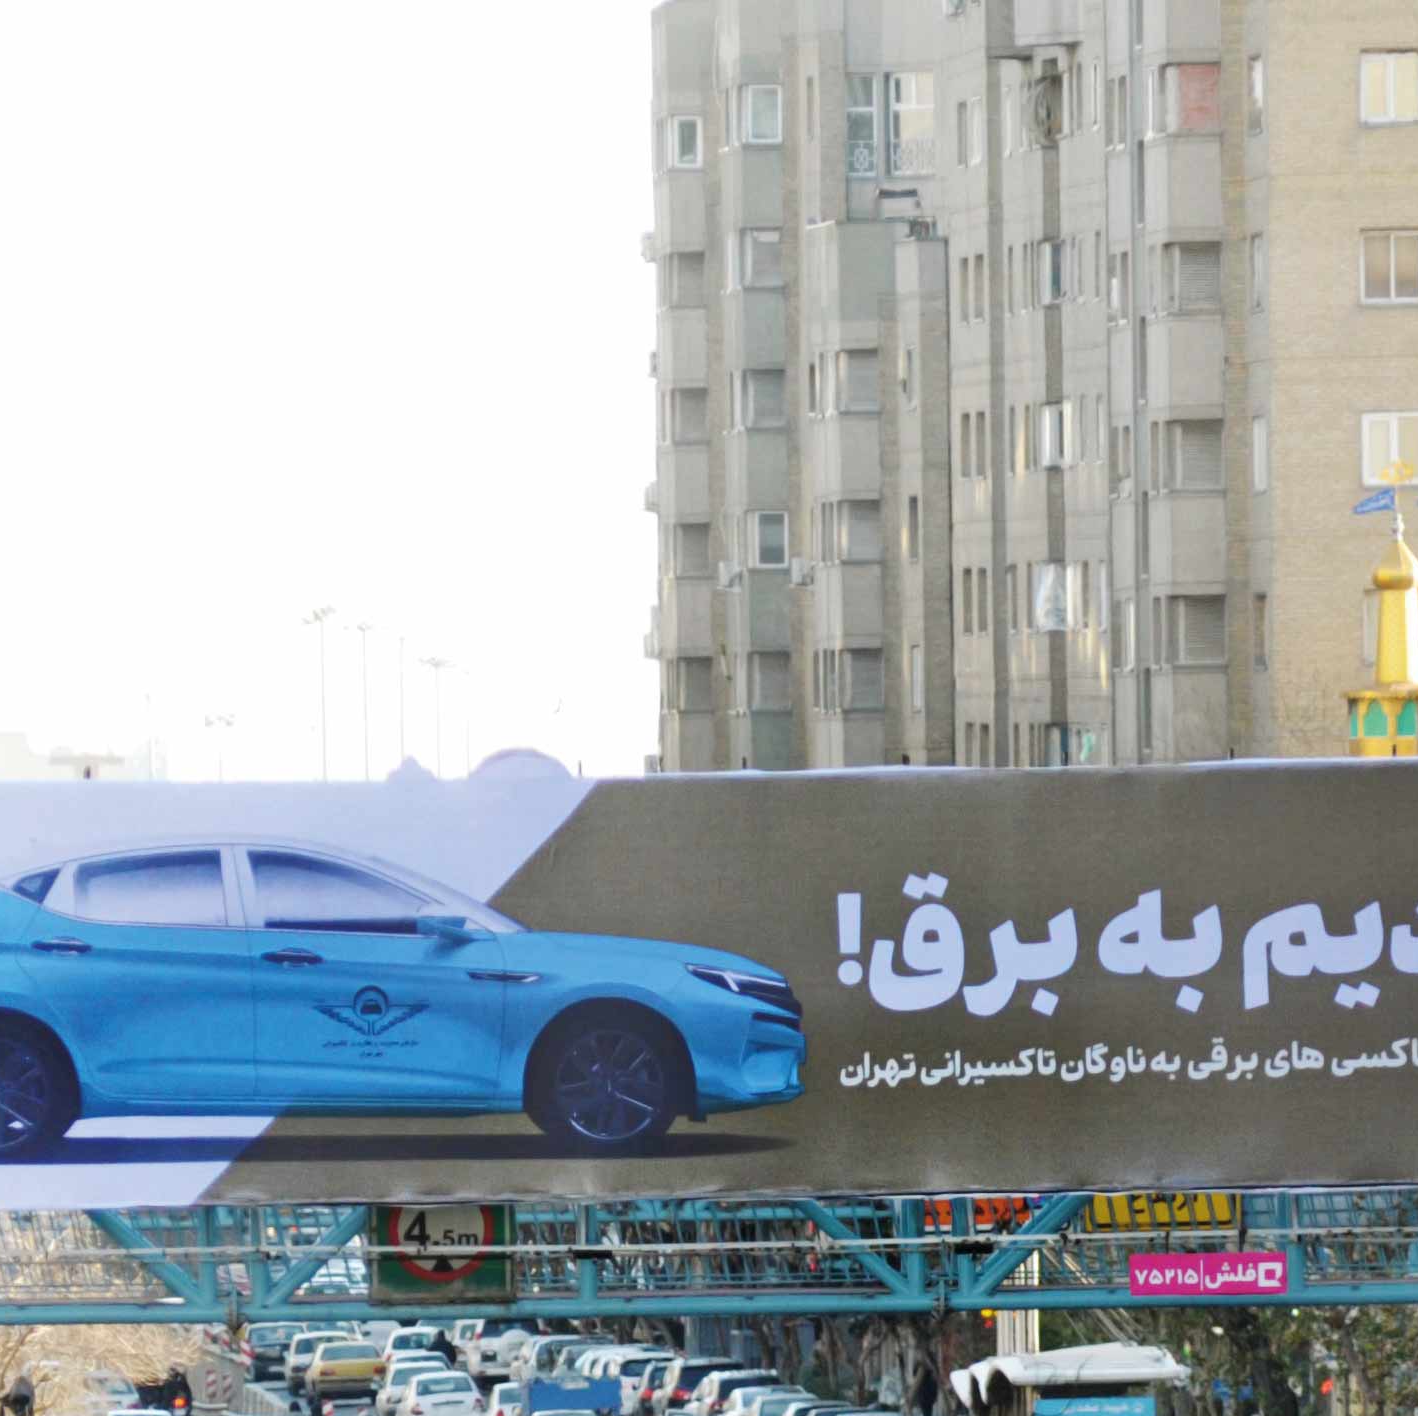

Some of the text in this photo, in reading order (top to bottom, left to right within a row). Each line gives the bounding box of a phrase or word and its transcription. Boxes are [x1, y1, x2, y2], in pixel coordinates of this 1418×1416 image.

[837, 872, 1078, 1017] برق!
[1098, 889, 1223, 1013] به
[839, 1052, 917, 1088] تهران
[920, 1047, 1057, 1086] تاکسیرانی
[1060, 1043, 1147, 1083] ناوگان
[1150, 1050, 1182, 1081] به
[1187, 1036, 1259, 1081] برقی
[1264, 1040, 1325, 1079] های
[1204, 1261, 1257, 1289] فلش
